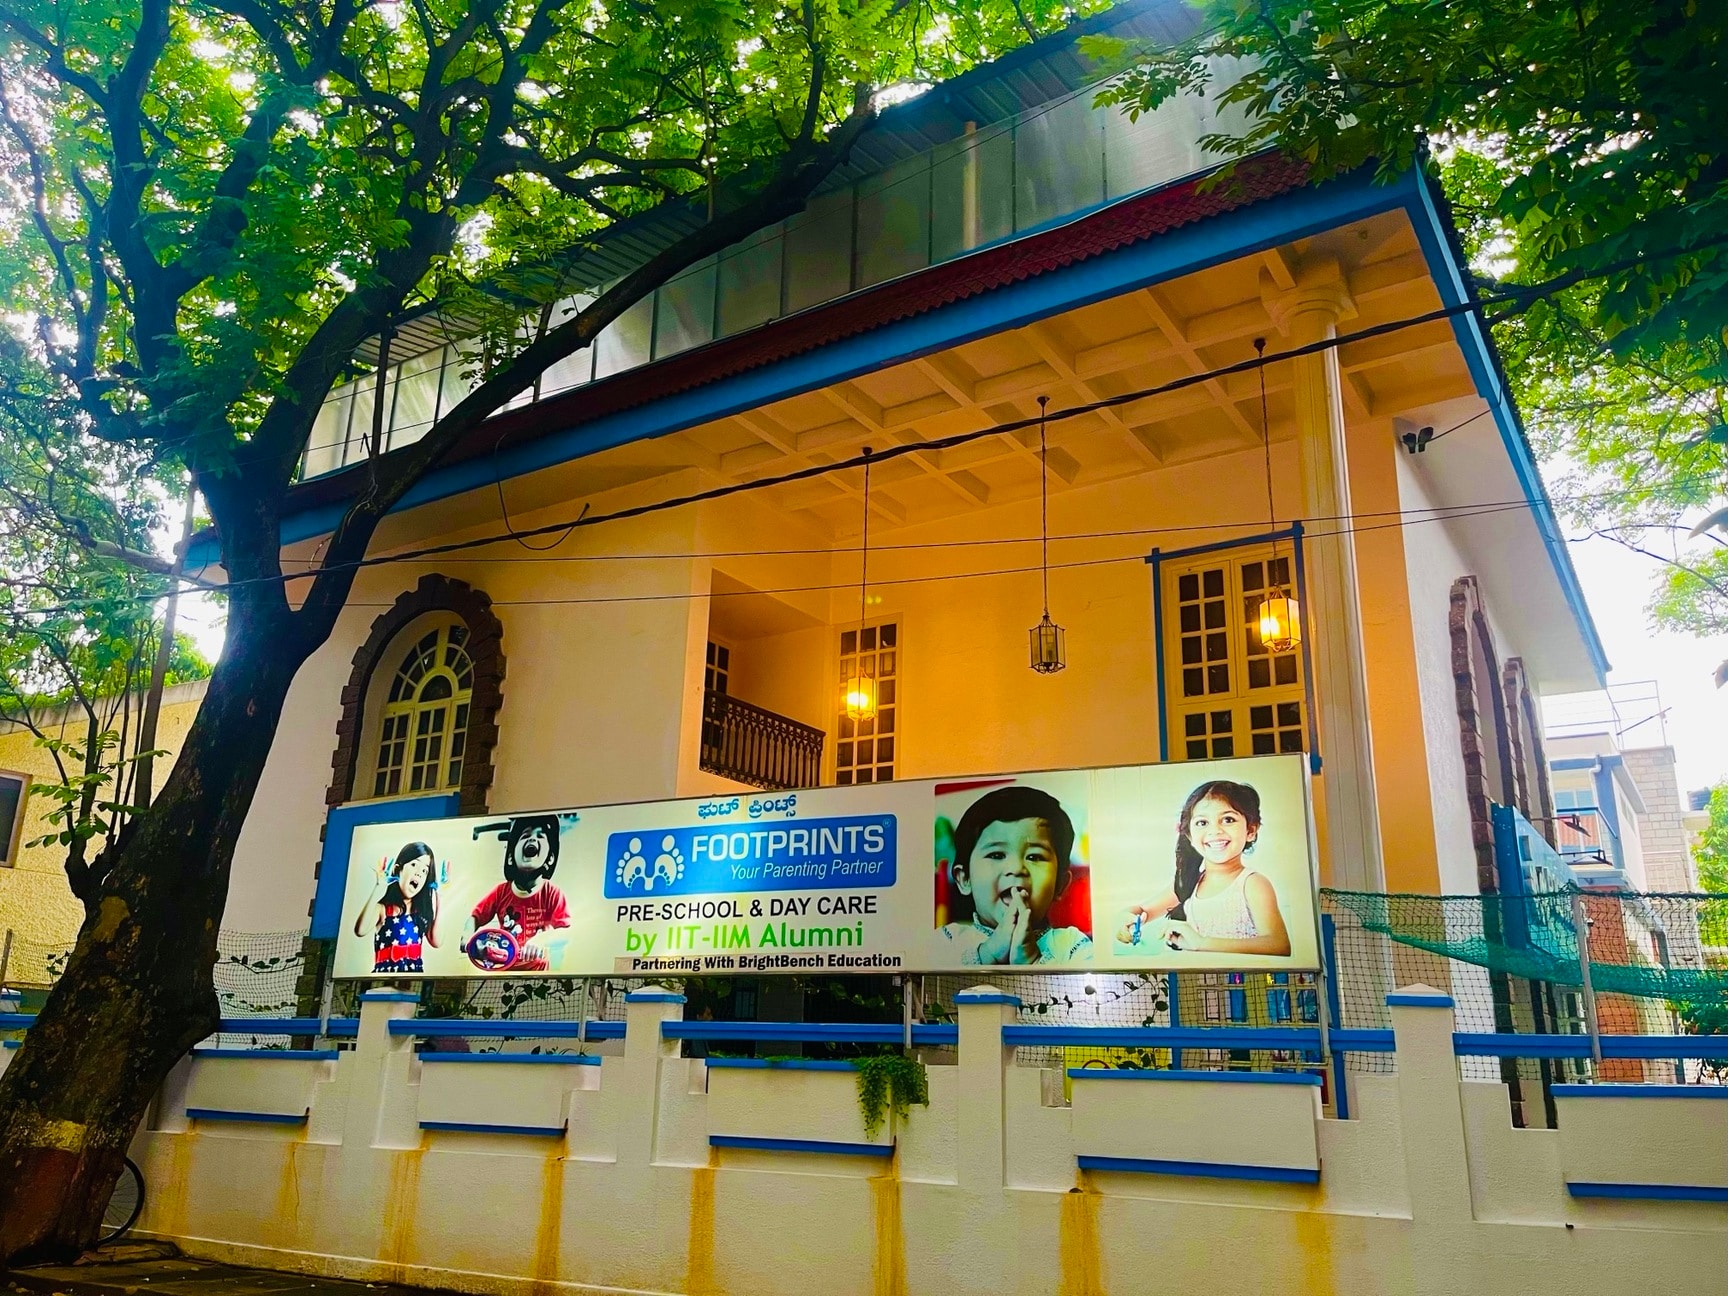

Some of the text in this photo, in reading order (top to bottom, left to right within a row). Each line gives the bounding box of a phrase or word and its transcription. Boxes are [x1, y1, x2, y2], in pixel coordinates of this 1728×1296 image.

[692, 826, 884, 862] FOOTPRINTS
[730, 858, 884, 880] Your Parenting Partner
[617, 894, 878, 922] PRE-SCHOOL & DAY CARE
[625, 921, 864, 955] by IIT-IIM Alumni
[633, 953, 902, 971] Partnering With BrightBench Education
